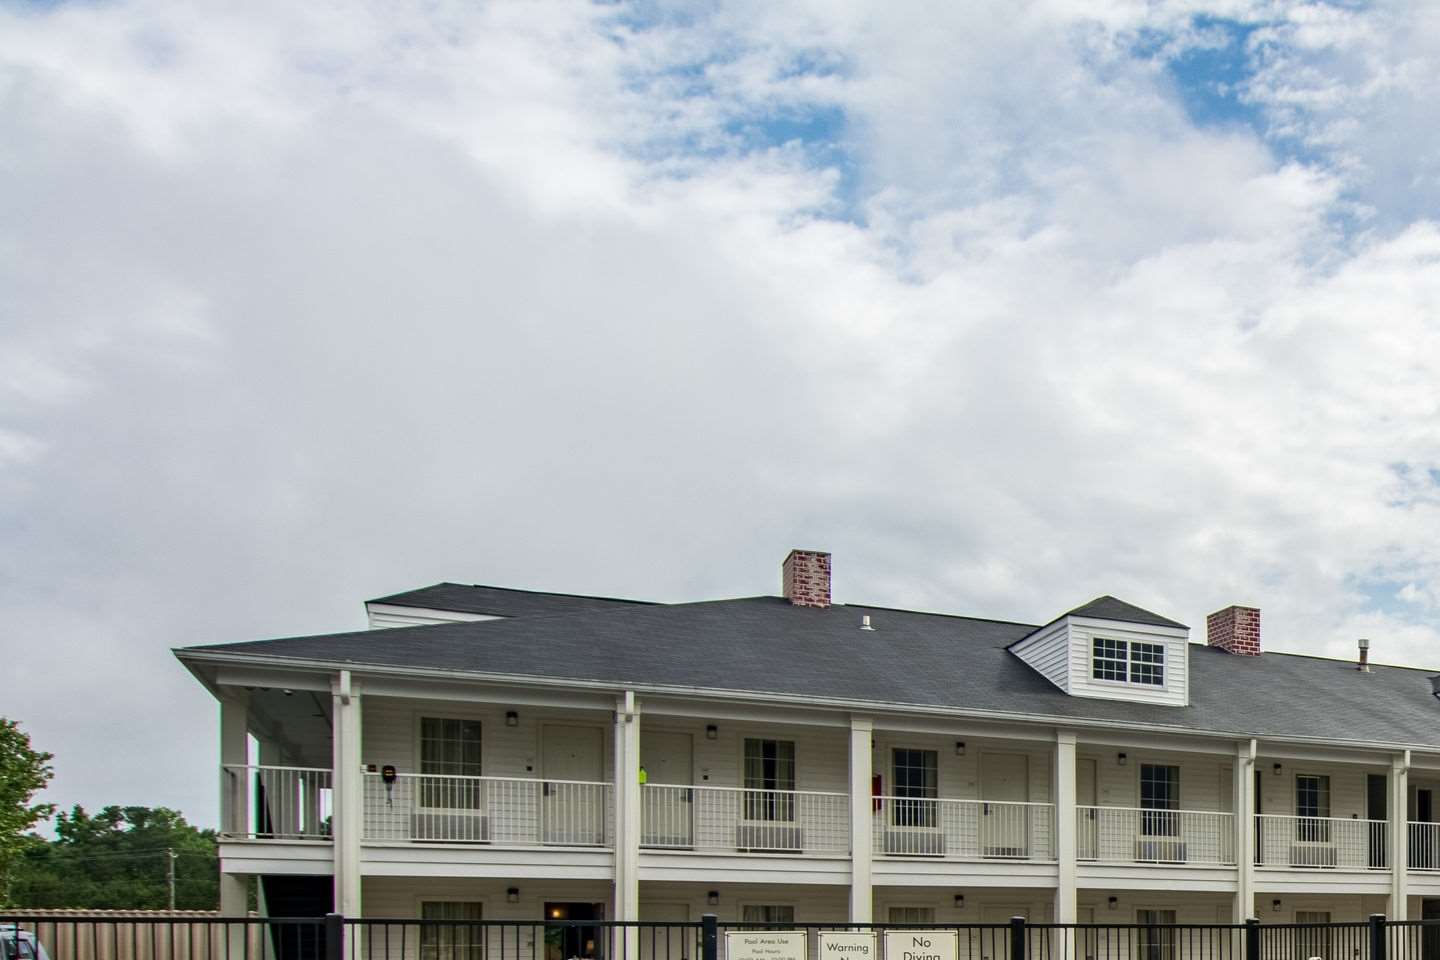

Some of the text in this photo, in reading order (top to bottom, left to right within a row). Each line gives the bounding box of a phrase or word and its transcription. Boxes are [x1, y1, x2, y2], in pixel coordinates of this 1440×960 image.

[744, 937, 789, 945] Pool Area Use
[912, 936, 931, 948] No
[826, 943, 869, 955] Warning
